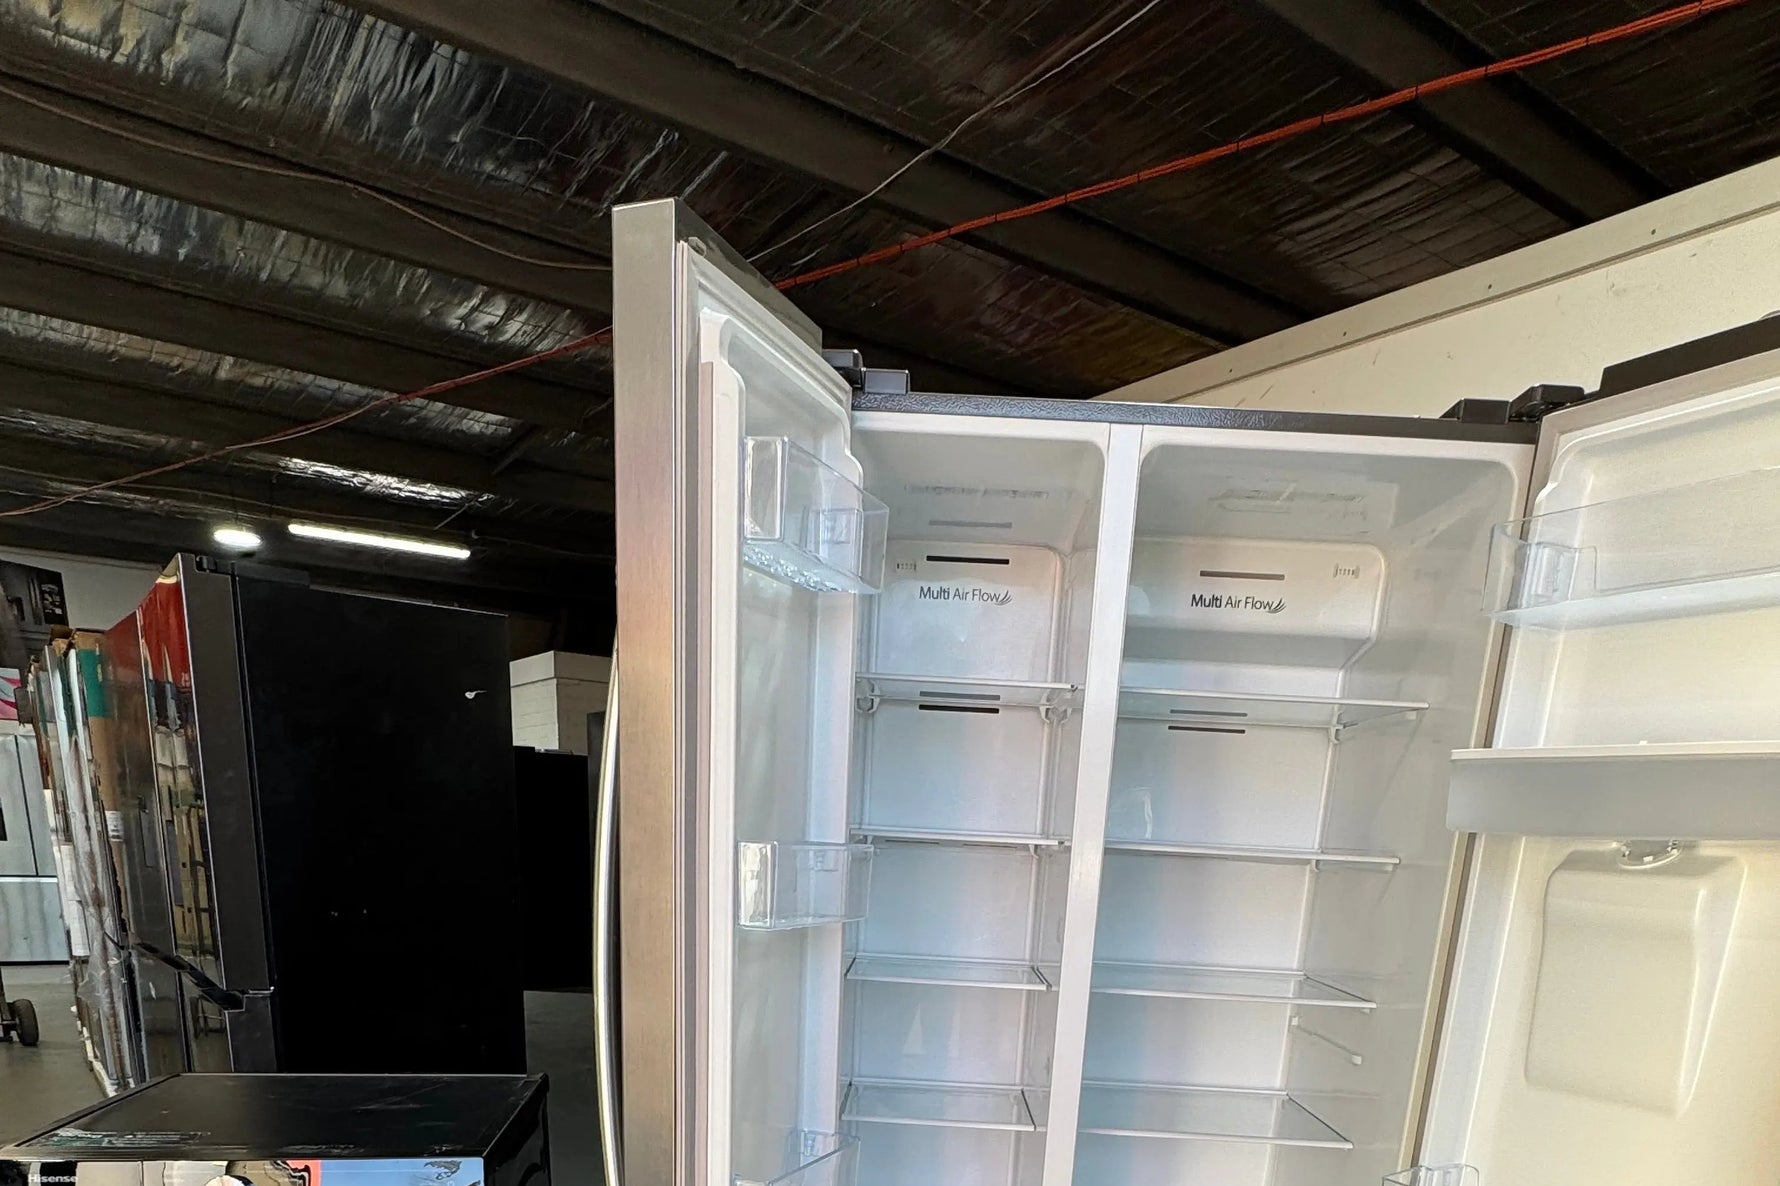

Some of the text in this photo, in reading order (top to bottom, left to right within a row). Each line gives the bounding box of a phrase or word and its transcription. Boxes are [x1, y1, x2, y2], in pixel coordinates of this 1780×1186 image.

[919, 586, 1001, 602] Multi Air Flow
[1191, 593, 1274, 611] Multi Air Flow
